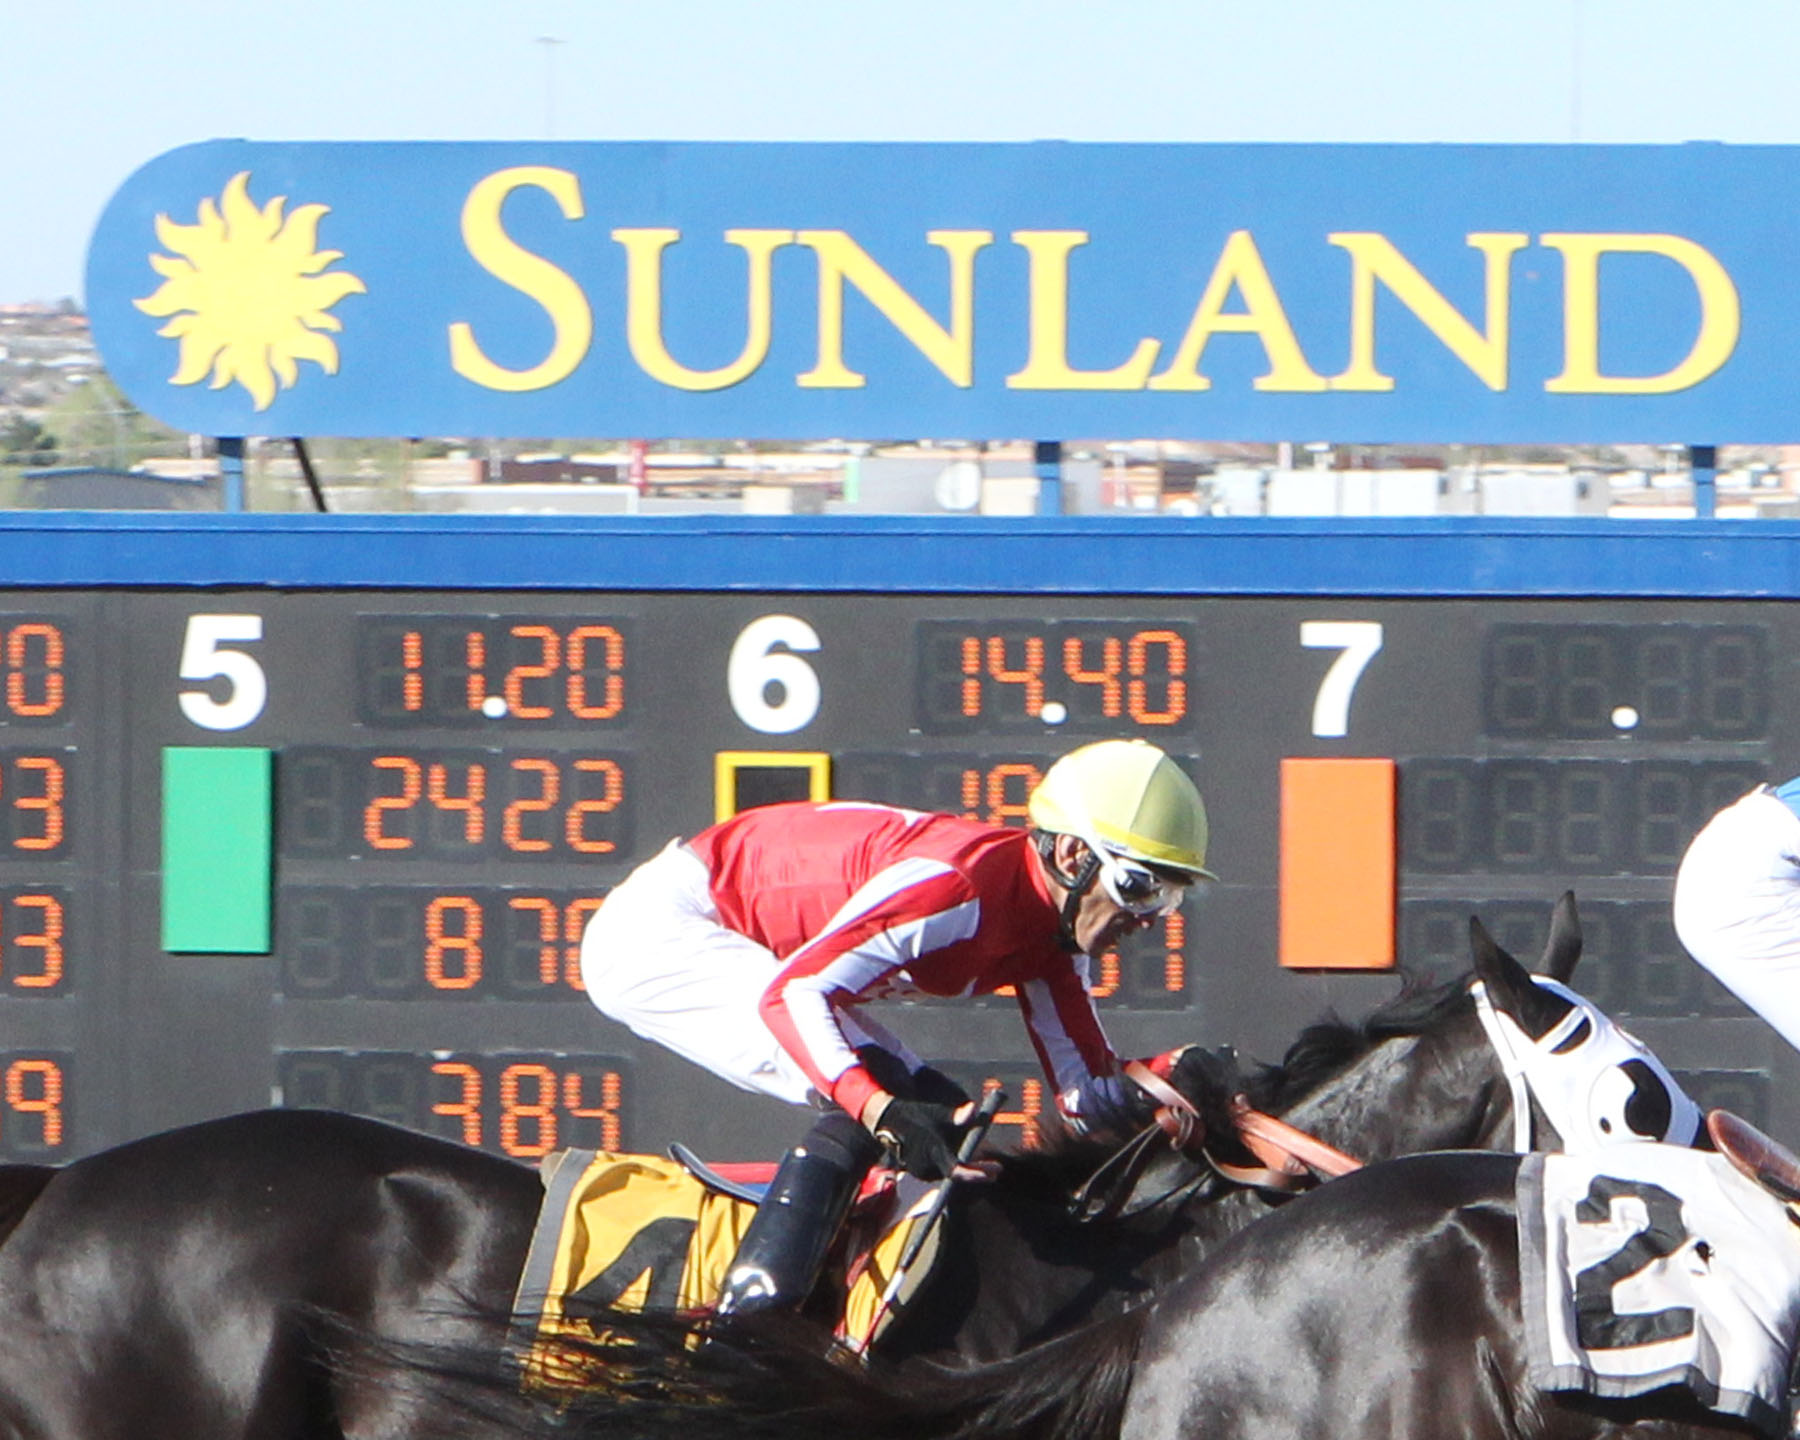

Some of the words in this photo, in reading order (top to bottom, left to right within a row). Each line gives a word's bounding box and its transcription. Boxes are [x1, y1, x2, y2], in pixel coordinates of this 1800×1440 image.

[449, 166, 1742, 394] SUNLAND
[178, 614, 268, 730] 5
[403, 625, 624, 719] 11.20
[727, 615, 822, 733] 6
[962, 630, 1187, 725] 14.40
[1300, 621, 1384, 737] 7
[364, 756, 624, 853] 2422
[5, 1060, 63, 1145] 9
[430, 1062, 622, 1157] 384
[1575, 1174, 1688, 1351] 2
